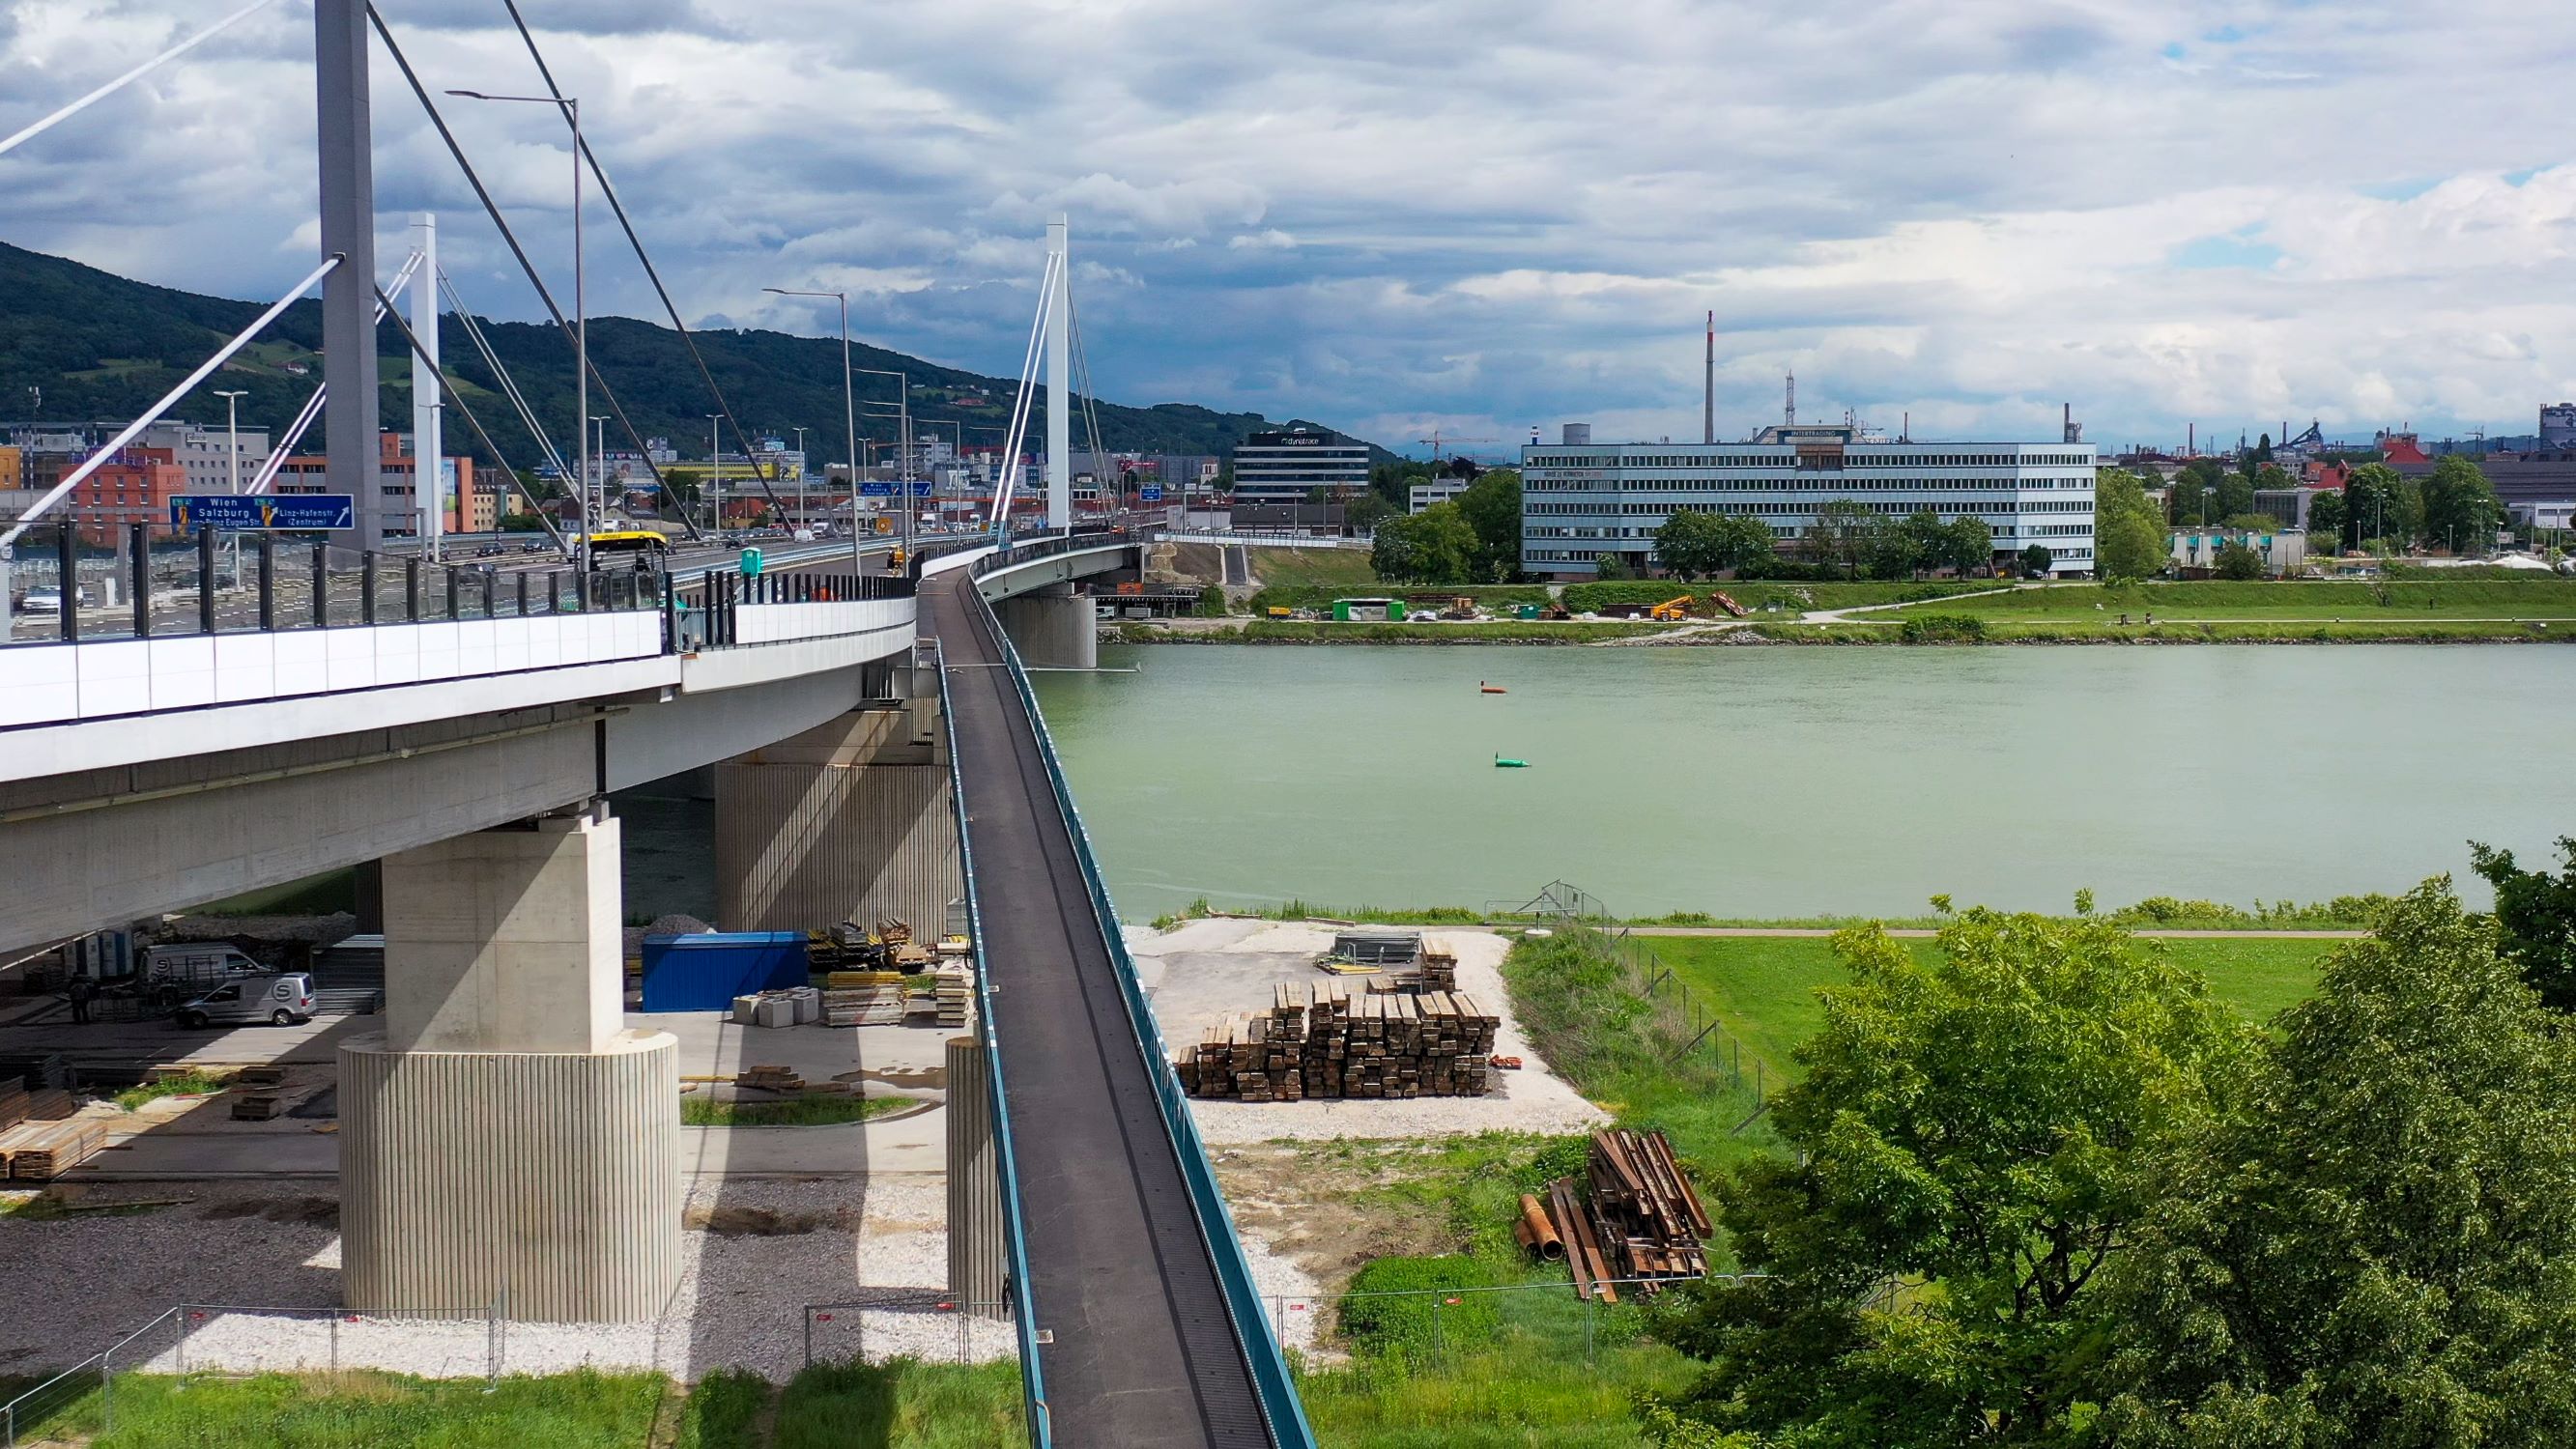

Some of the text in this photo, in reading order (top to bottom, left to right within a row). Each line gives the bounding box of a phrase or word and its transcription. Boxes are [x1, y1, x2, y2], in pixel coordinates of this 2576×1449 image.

[210, 497, 238, 506] Wien
[198, 508, 249, 519] Salzburg
[225, 518, 248, 526] Eugen
